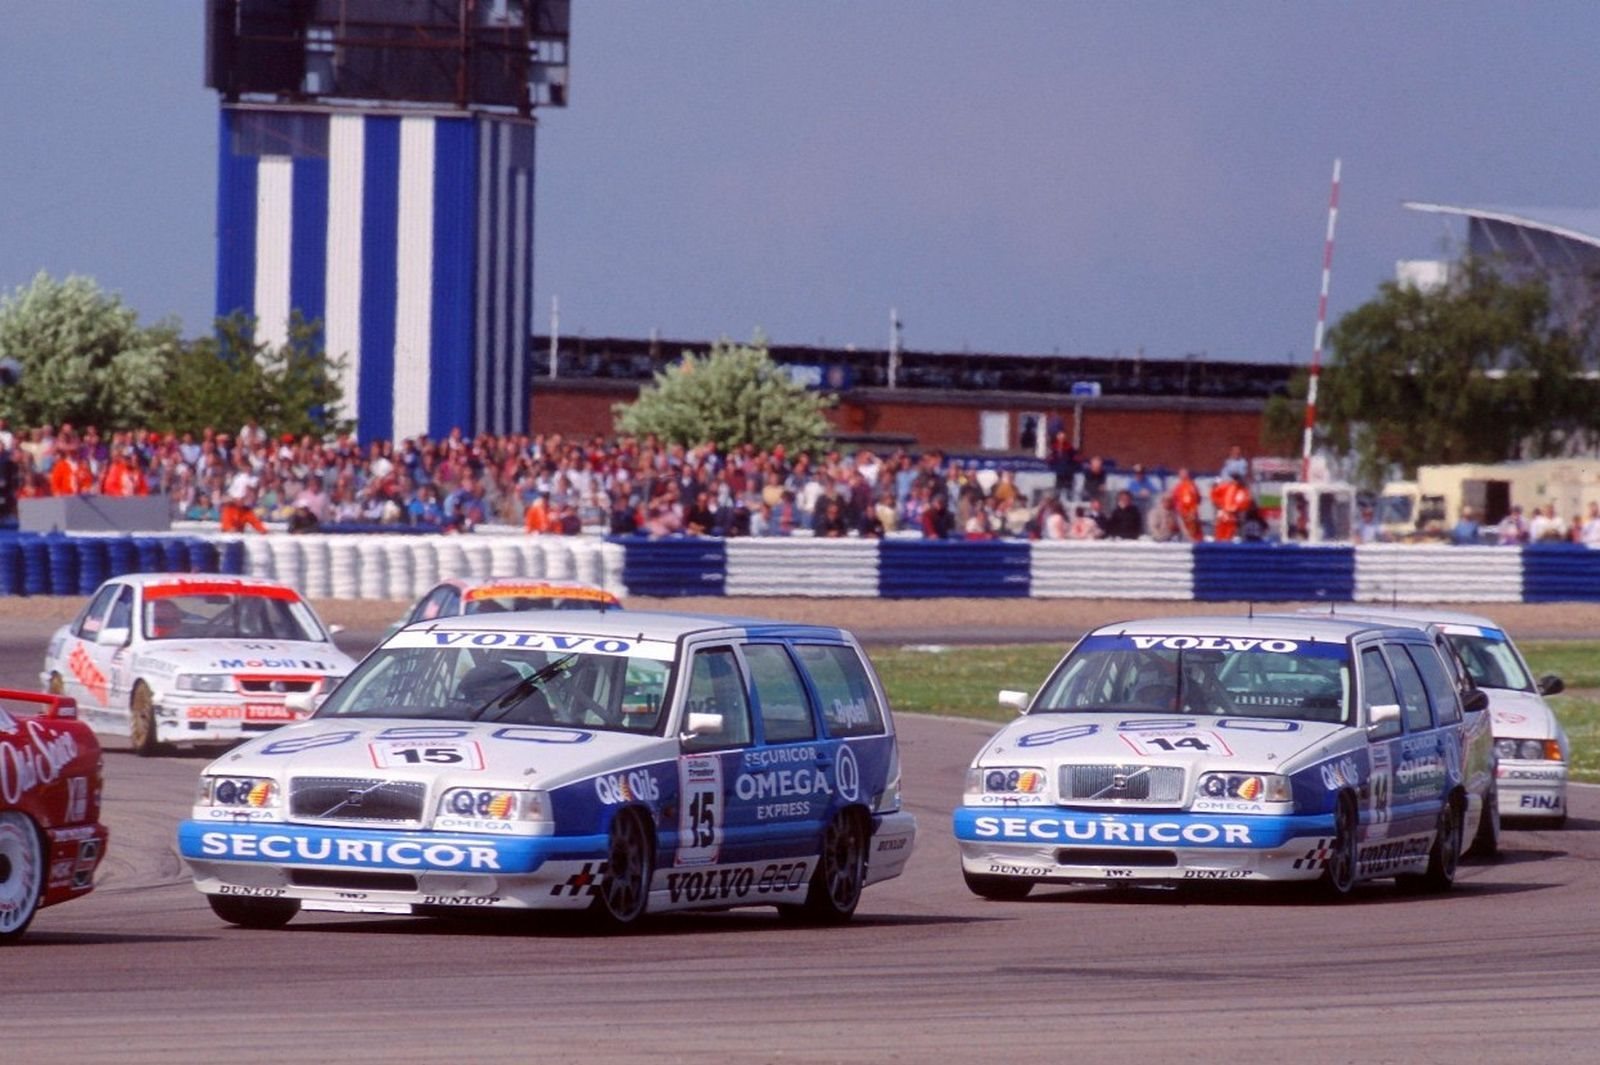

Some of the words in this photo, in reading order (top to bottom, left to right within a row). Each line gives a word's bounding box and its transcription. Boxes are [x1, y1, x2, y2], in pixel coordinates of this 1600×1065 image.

[431, 632, 630, 653] VOLVO
[1130, 635, 1298, 654] VOLVO
[219, 658, 297, 669] Mobil
[1145, 737, 1211, 751] 14
[392, 747, 464, 764] 15
[744, 746, 817, 767] SECURICOR
[595, 776, 624, 804] Q8
[628, 769, 660, 801] Oils
[734, 768, 834, 801] OMEGA
[986, 770, 1021, 791] Q8
[1205, 775, 1242, 798] Q8
[217, 780, 252, 804] Q8
[1520, 795, 1560, 809] FINA
[452, 790, 492, 816] Q8
[757, 800, 811, 820] EXPRESS
[1196, 801, 1262, 812] OMEGA
[441, 819, 514, 831] OMEGA
[689, 791, 715, 849] 15
[974, 816, 1253, 844] SECURICOR
[201, 831, 500, 870] SECURICOR
[988, 864, 1053, 876] DUNLOP
[1183, 869, 1253, 879] DUNLOP
[219, 885, 286, 897] DUNLOP
[423, 895, 500, 906] DUNLOP
[667, 867, 754, 904] VOLVO
